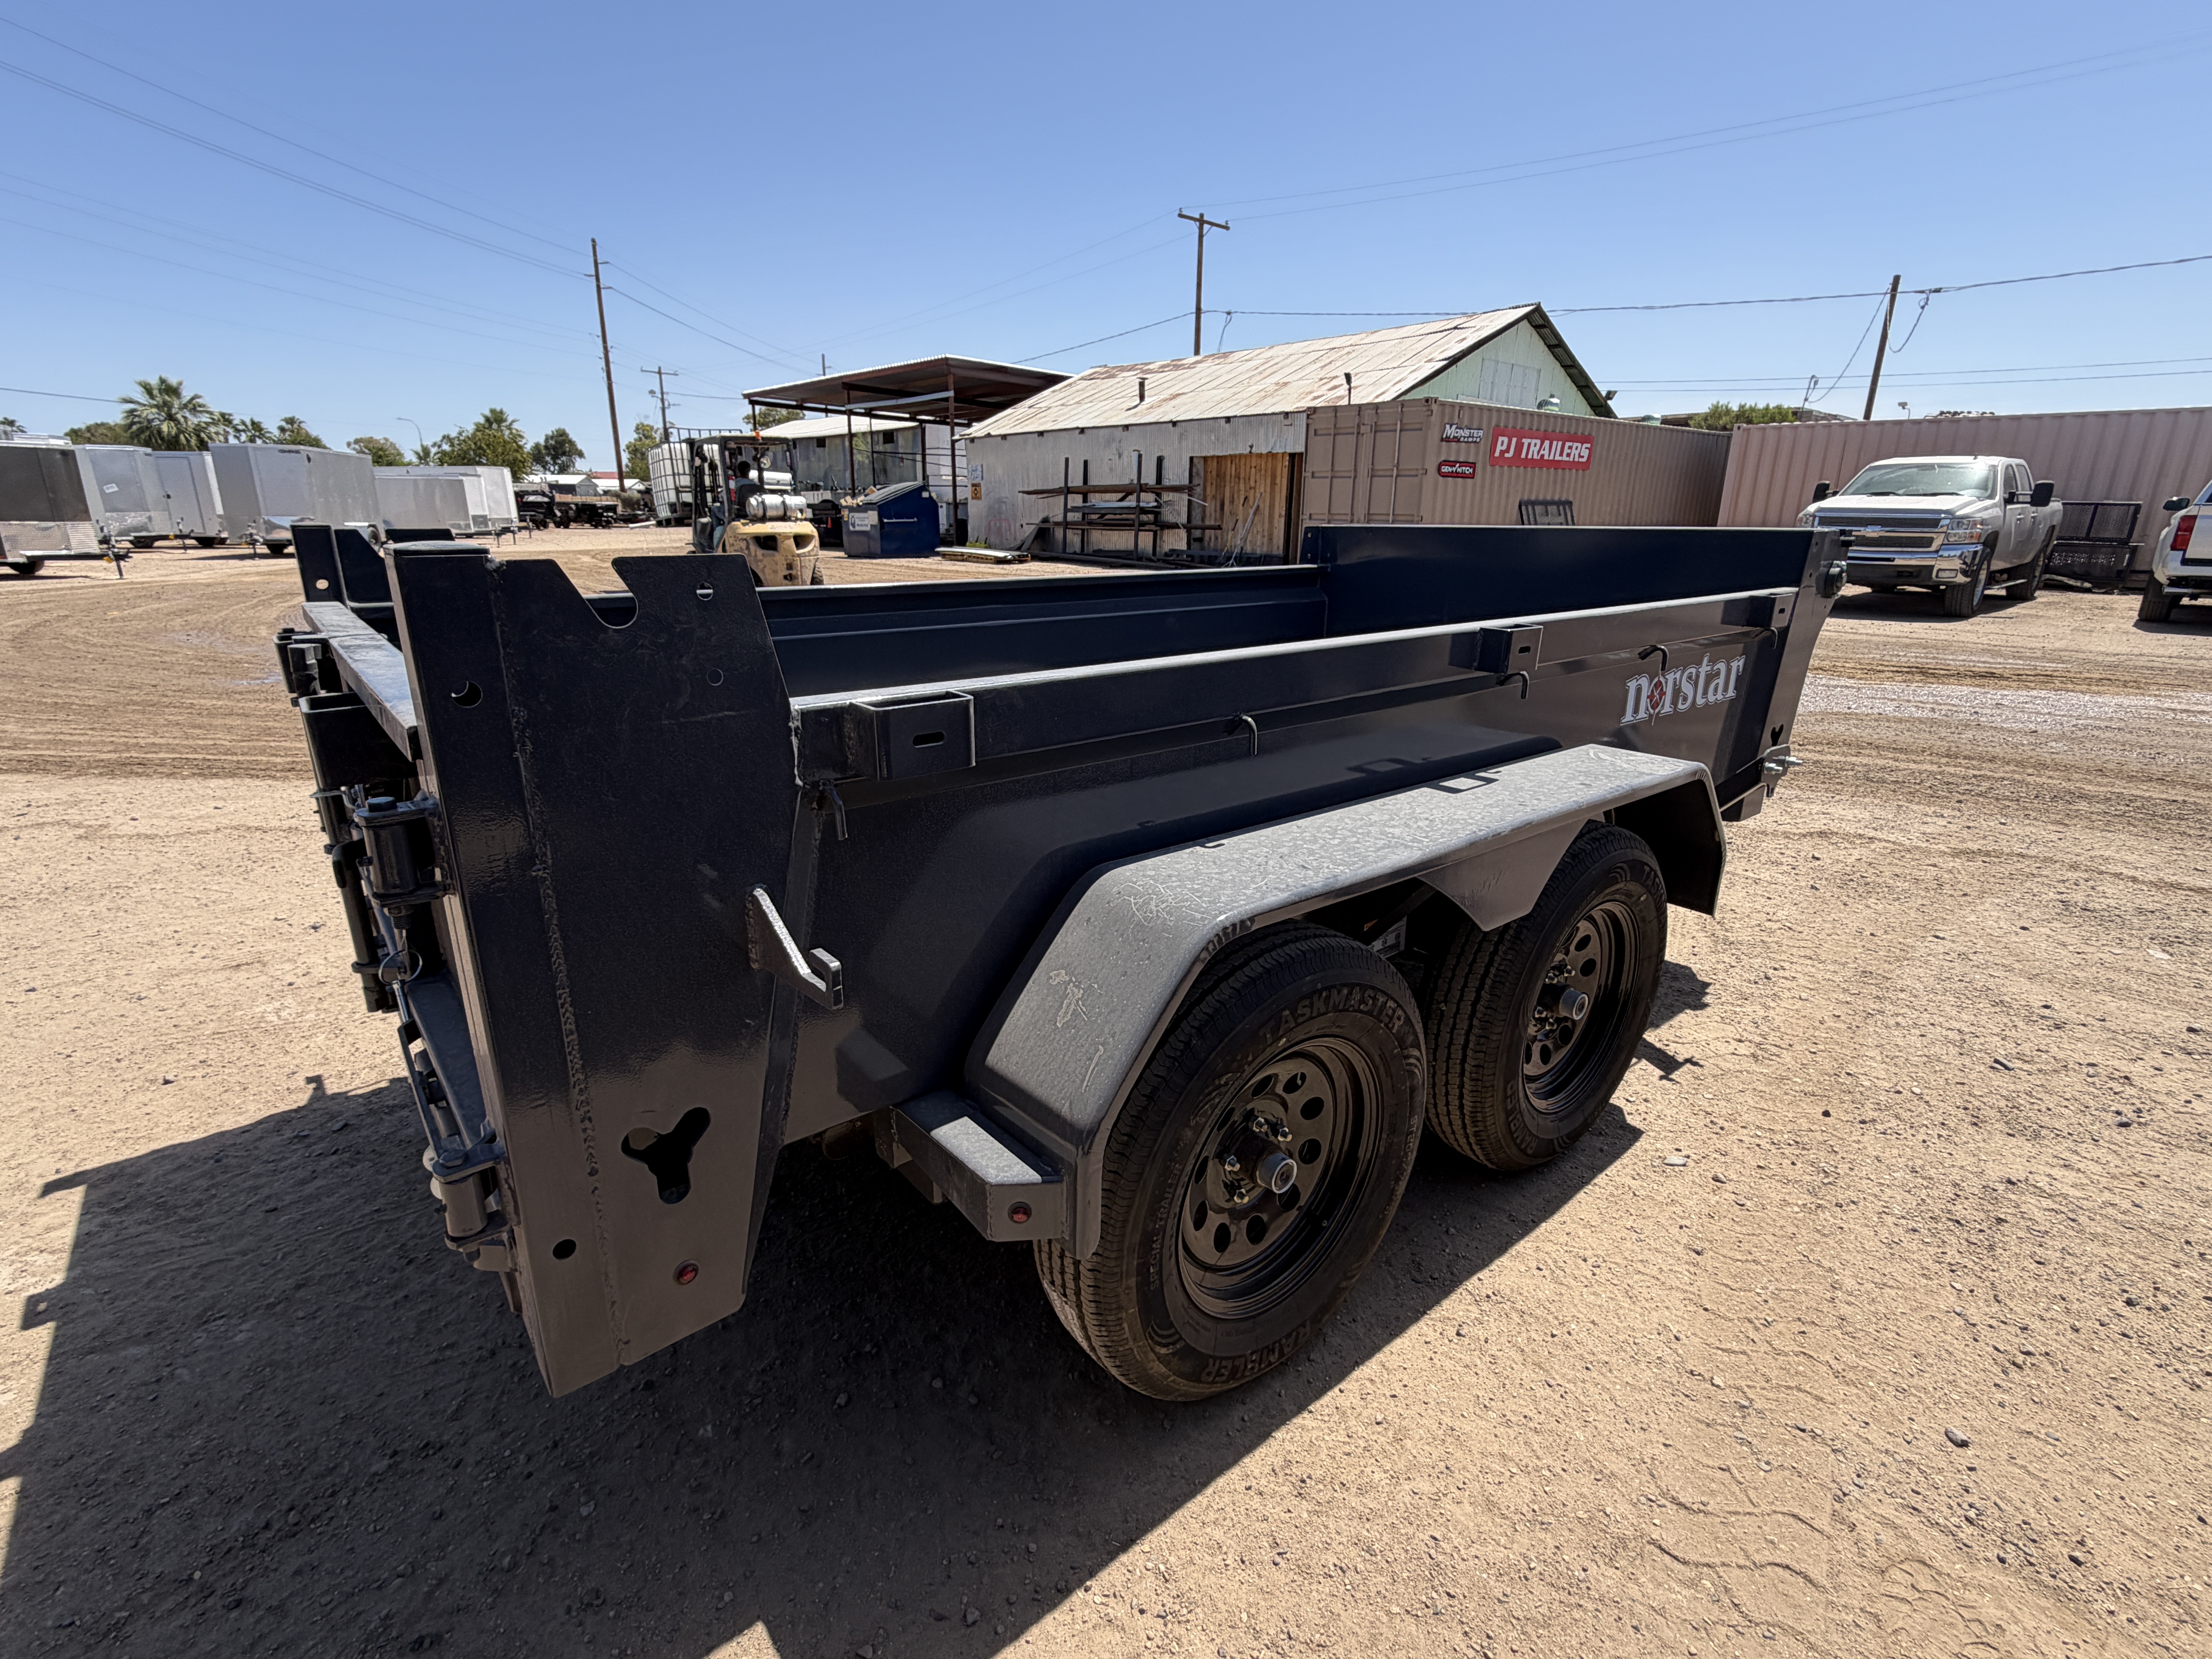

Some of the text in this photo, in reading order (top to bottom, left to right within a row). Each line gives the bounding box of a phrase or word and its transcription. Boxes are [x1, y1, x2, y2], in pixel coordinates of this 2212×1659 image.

[1443, 424, 1484, 438] MONSTER
[1494, 436, 1591, 462] PJ TRAILERS
[1620, 653, 1746, 726] norstar
[1259, 986, 1406, 1045] TASKMASTER
[1149, 1230, 1163, 1291] SPECIAL
[1156, 1162, 1183, 1228] TRAILER
[1201, 1319, 1311, 1382] RAMBLER
